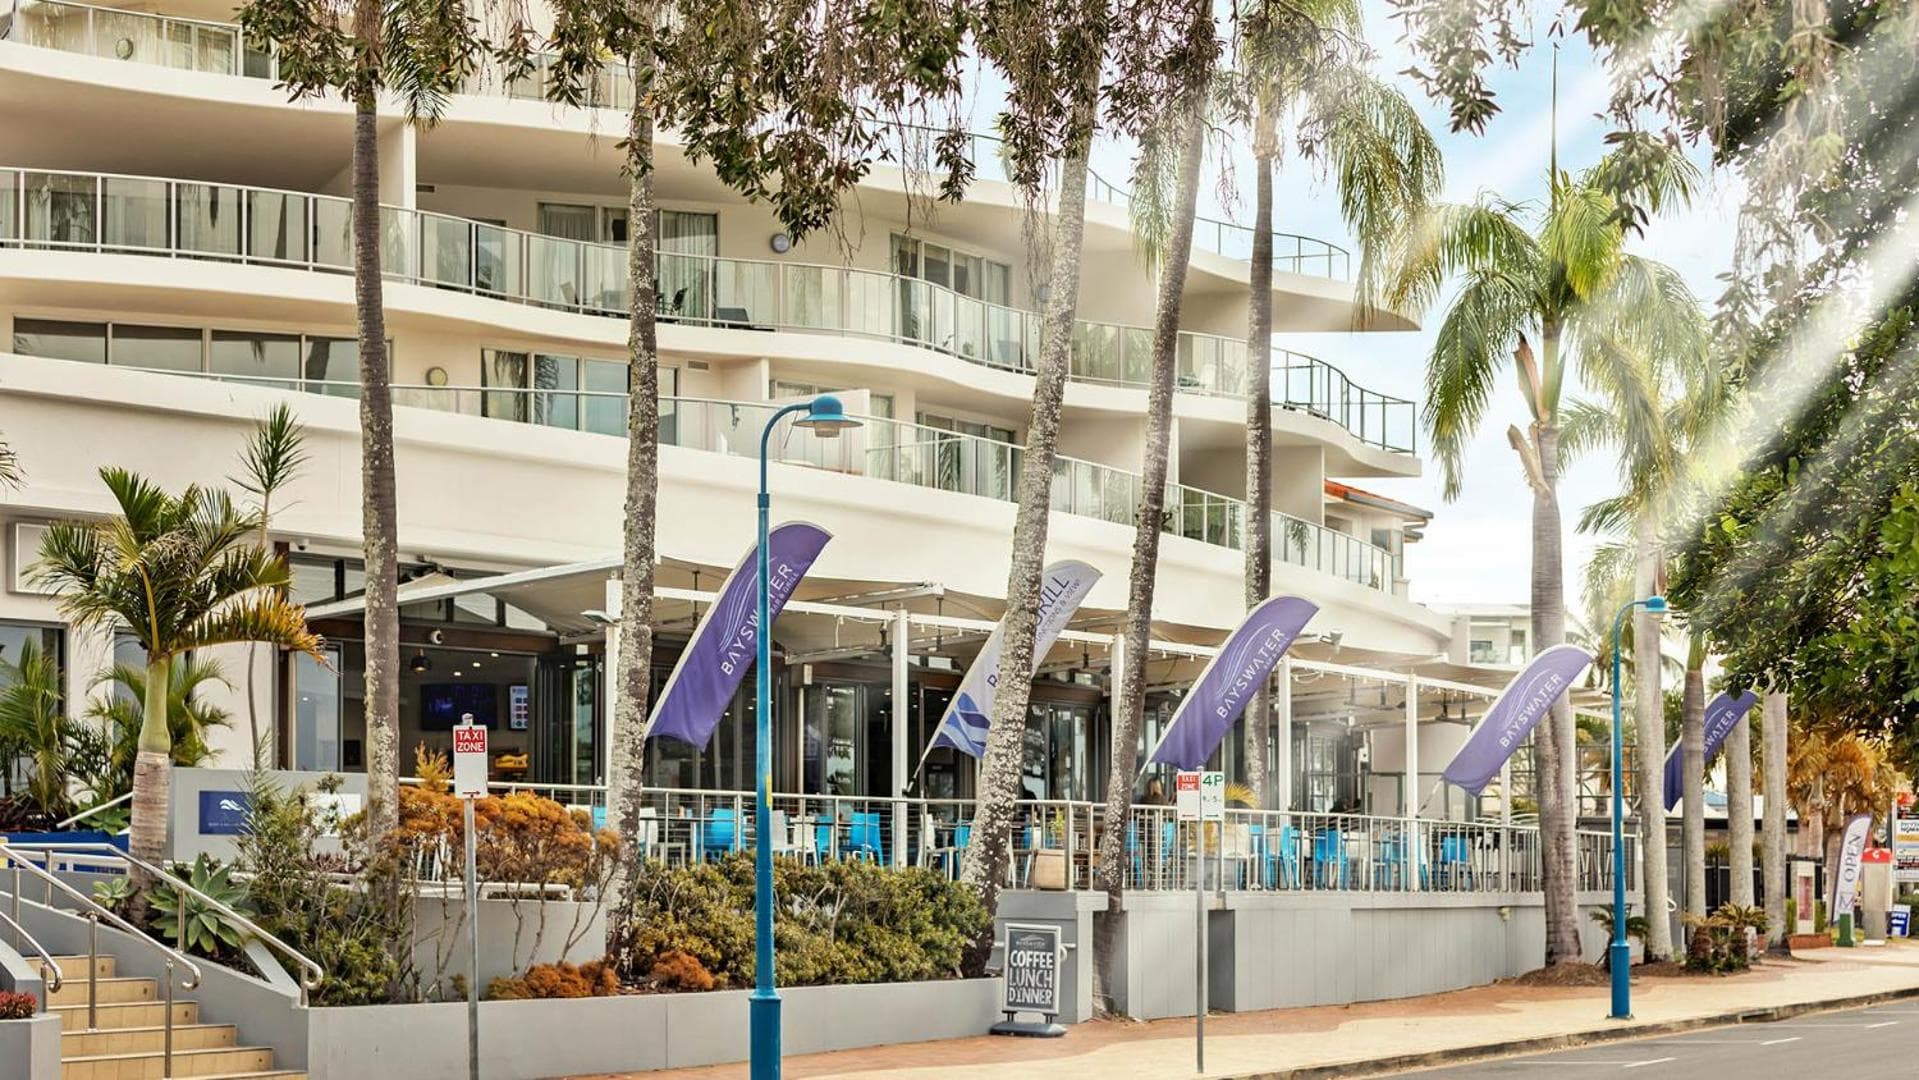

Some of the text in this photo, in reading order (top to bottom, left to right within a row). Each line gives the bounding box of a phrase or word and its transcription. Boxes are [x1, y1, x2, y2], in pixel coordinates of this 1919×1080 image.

[720, 563, 793, 675] BAYSWER
[1216, 628, 1285, 719] BAYSWATER
[1500, 673, 1562, 747] BAYSWATER
[457, 731, 483, 740] TAXI
[457, 742, 484, 752] ZONE
[1202, 774, 1224, 786] 4P
[1844, 835, 1861, 882] OPEN
[1010, 949, 1054, 968] COFFEE
[1009, 967, 1053, 988] LUNCH
[1008, 987, 1053, 1004] DINNER
